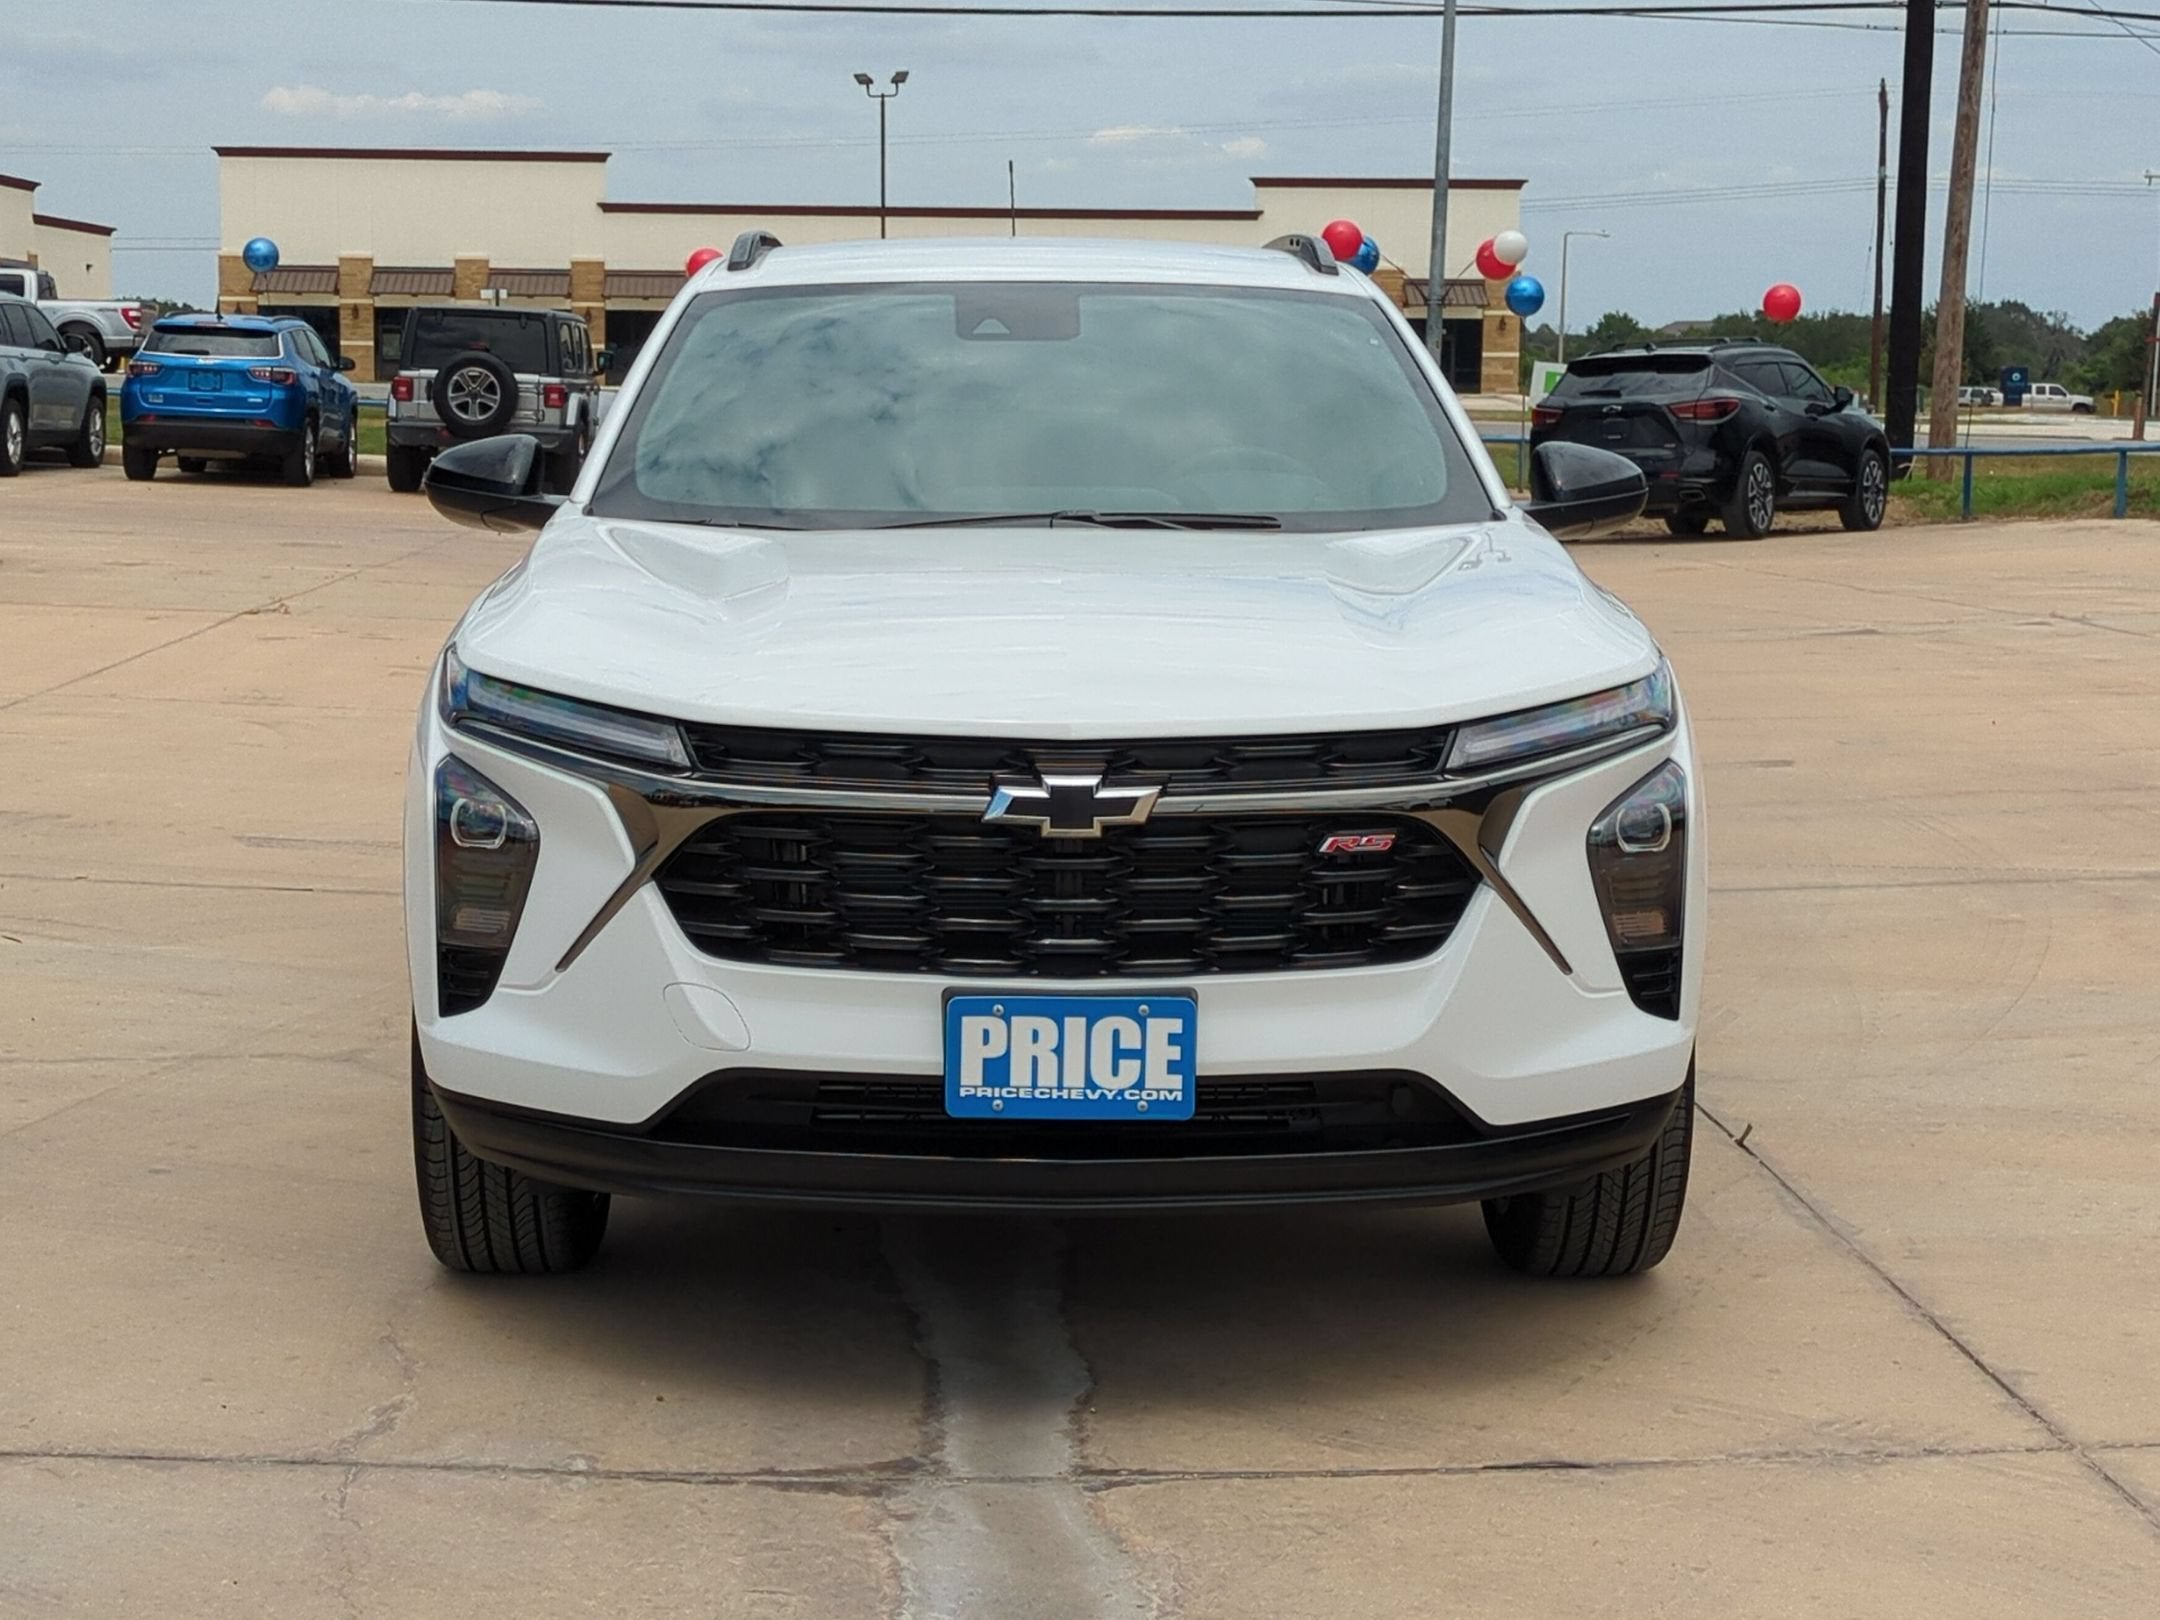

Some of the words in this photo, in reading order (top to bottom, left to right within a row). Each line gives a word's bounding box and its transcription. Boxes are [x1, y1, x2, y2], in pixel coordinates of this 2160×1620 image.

[1319, 834, 1396, 853] RS
[960, 1015, 1183, 1090] PRICE
[959, 1087, 1183, 1101] PRICECHEVY.COM
